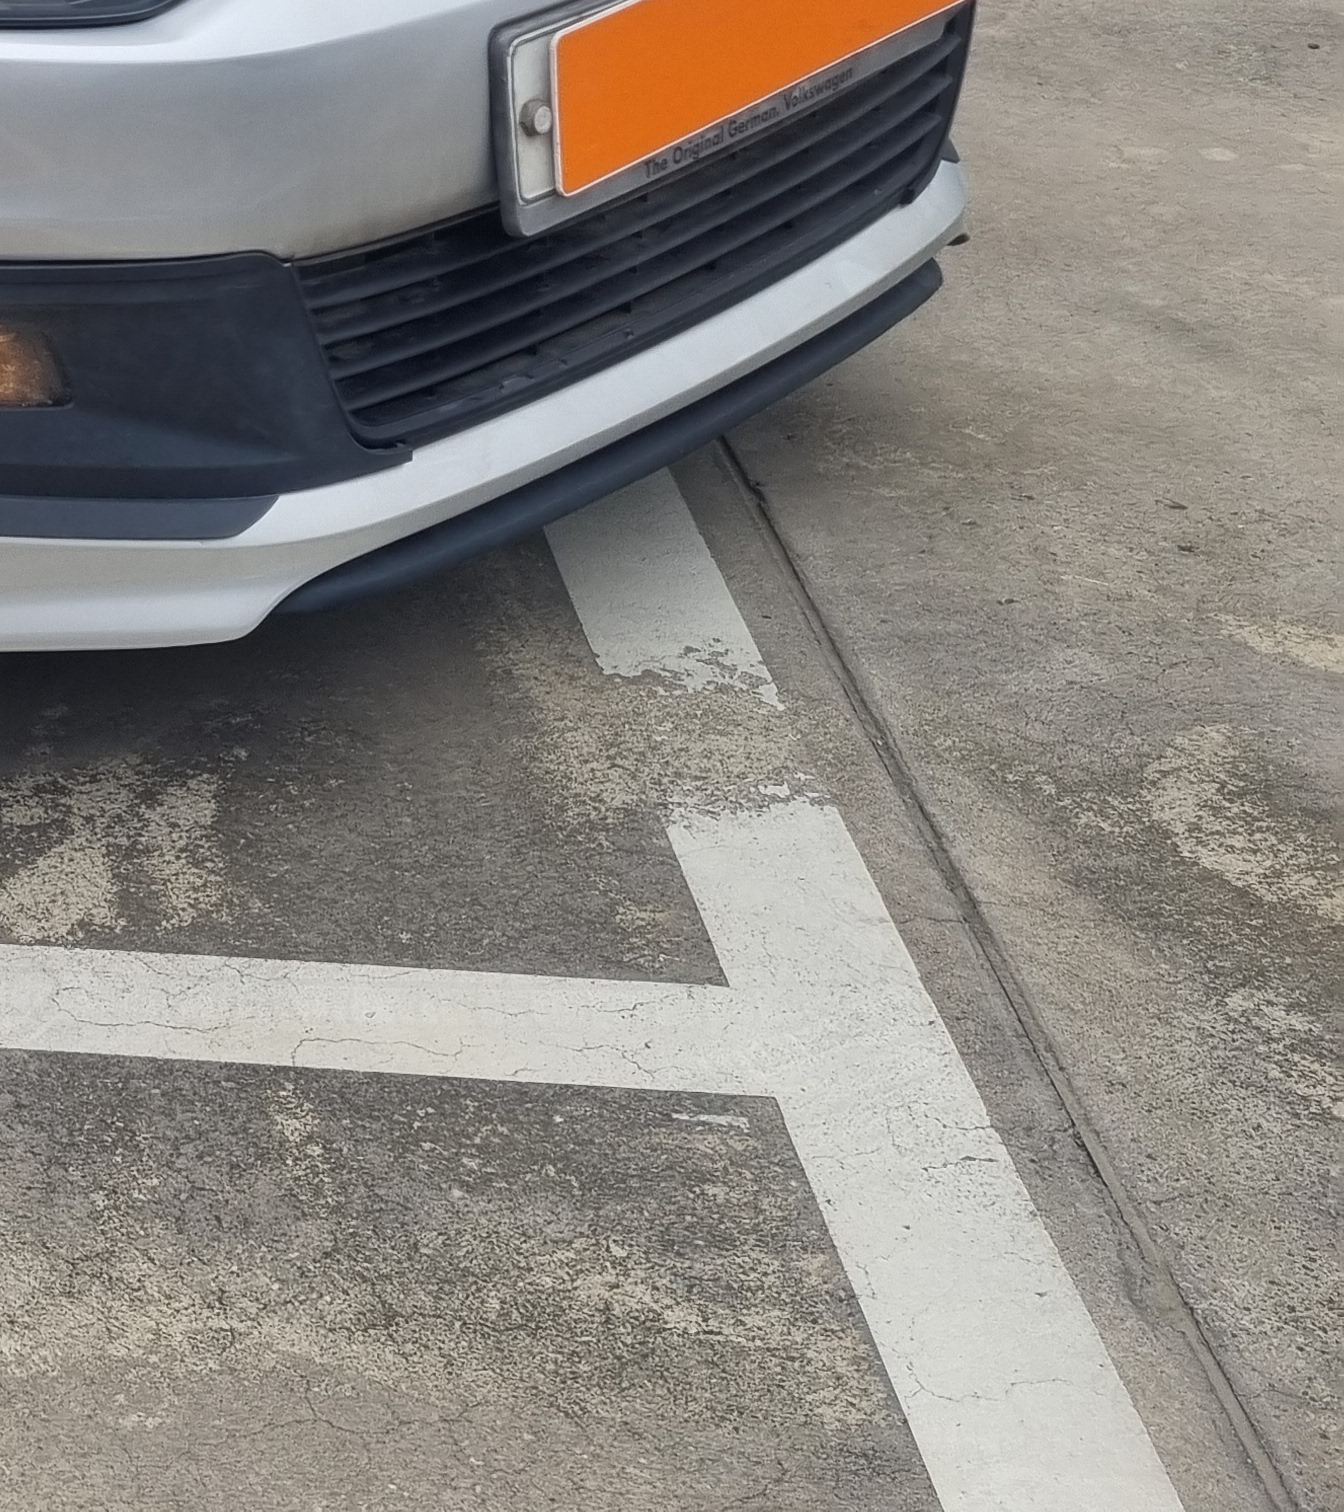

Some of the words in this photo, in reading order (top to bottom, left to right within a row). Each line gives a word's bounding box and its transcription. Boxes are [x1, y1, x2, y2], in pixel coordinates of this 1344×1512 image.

[643, 158, 668, 179] The
[672, 127, 724, 164] Original
[783, 67, 853, 110] Volkswagen
